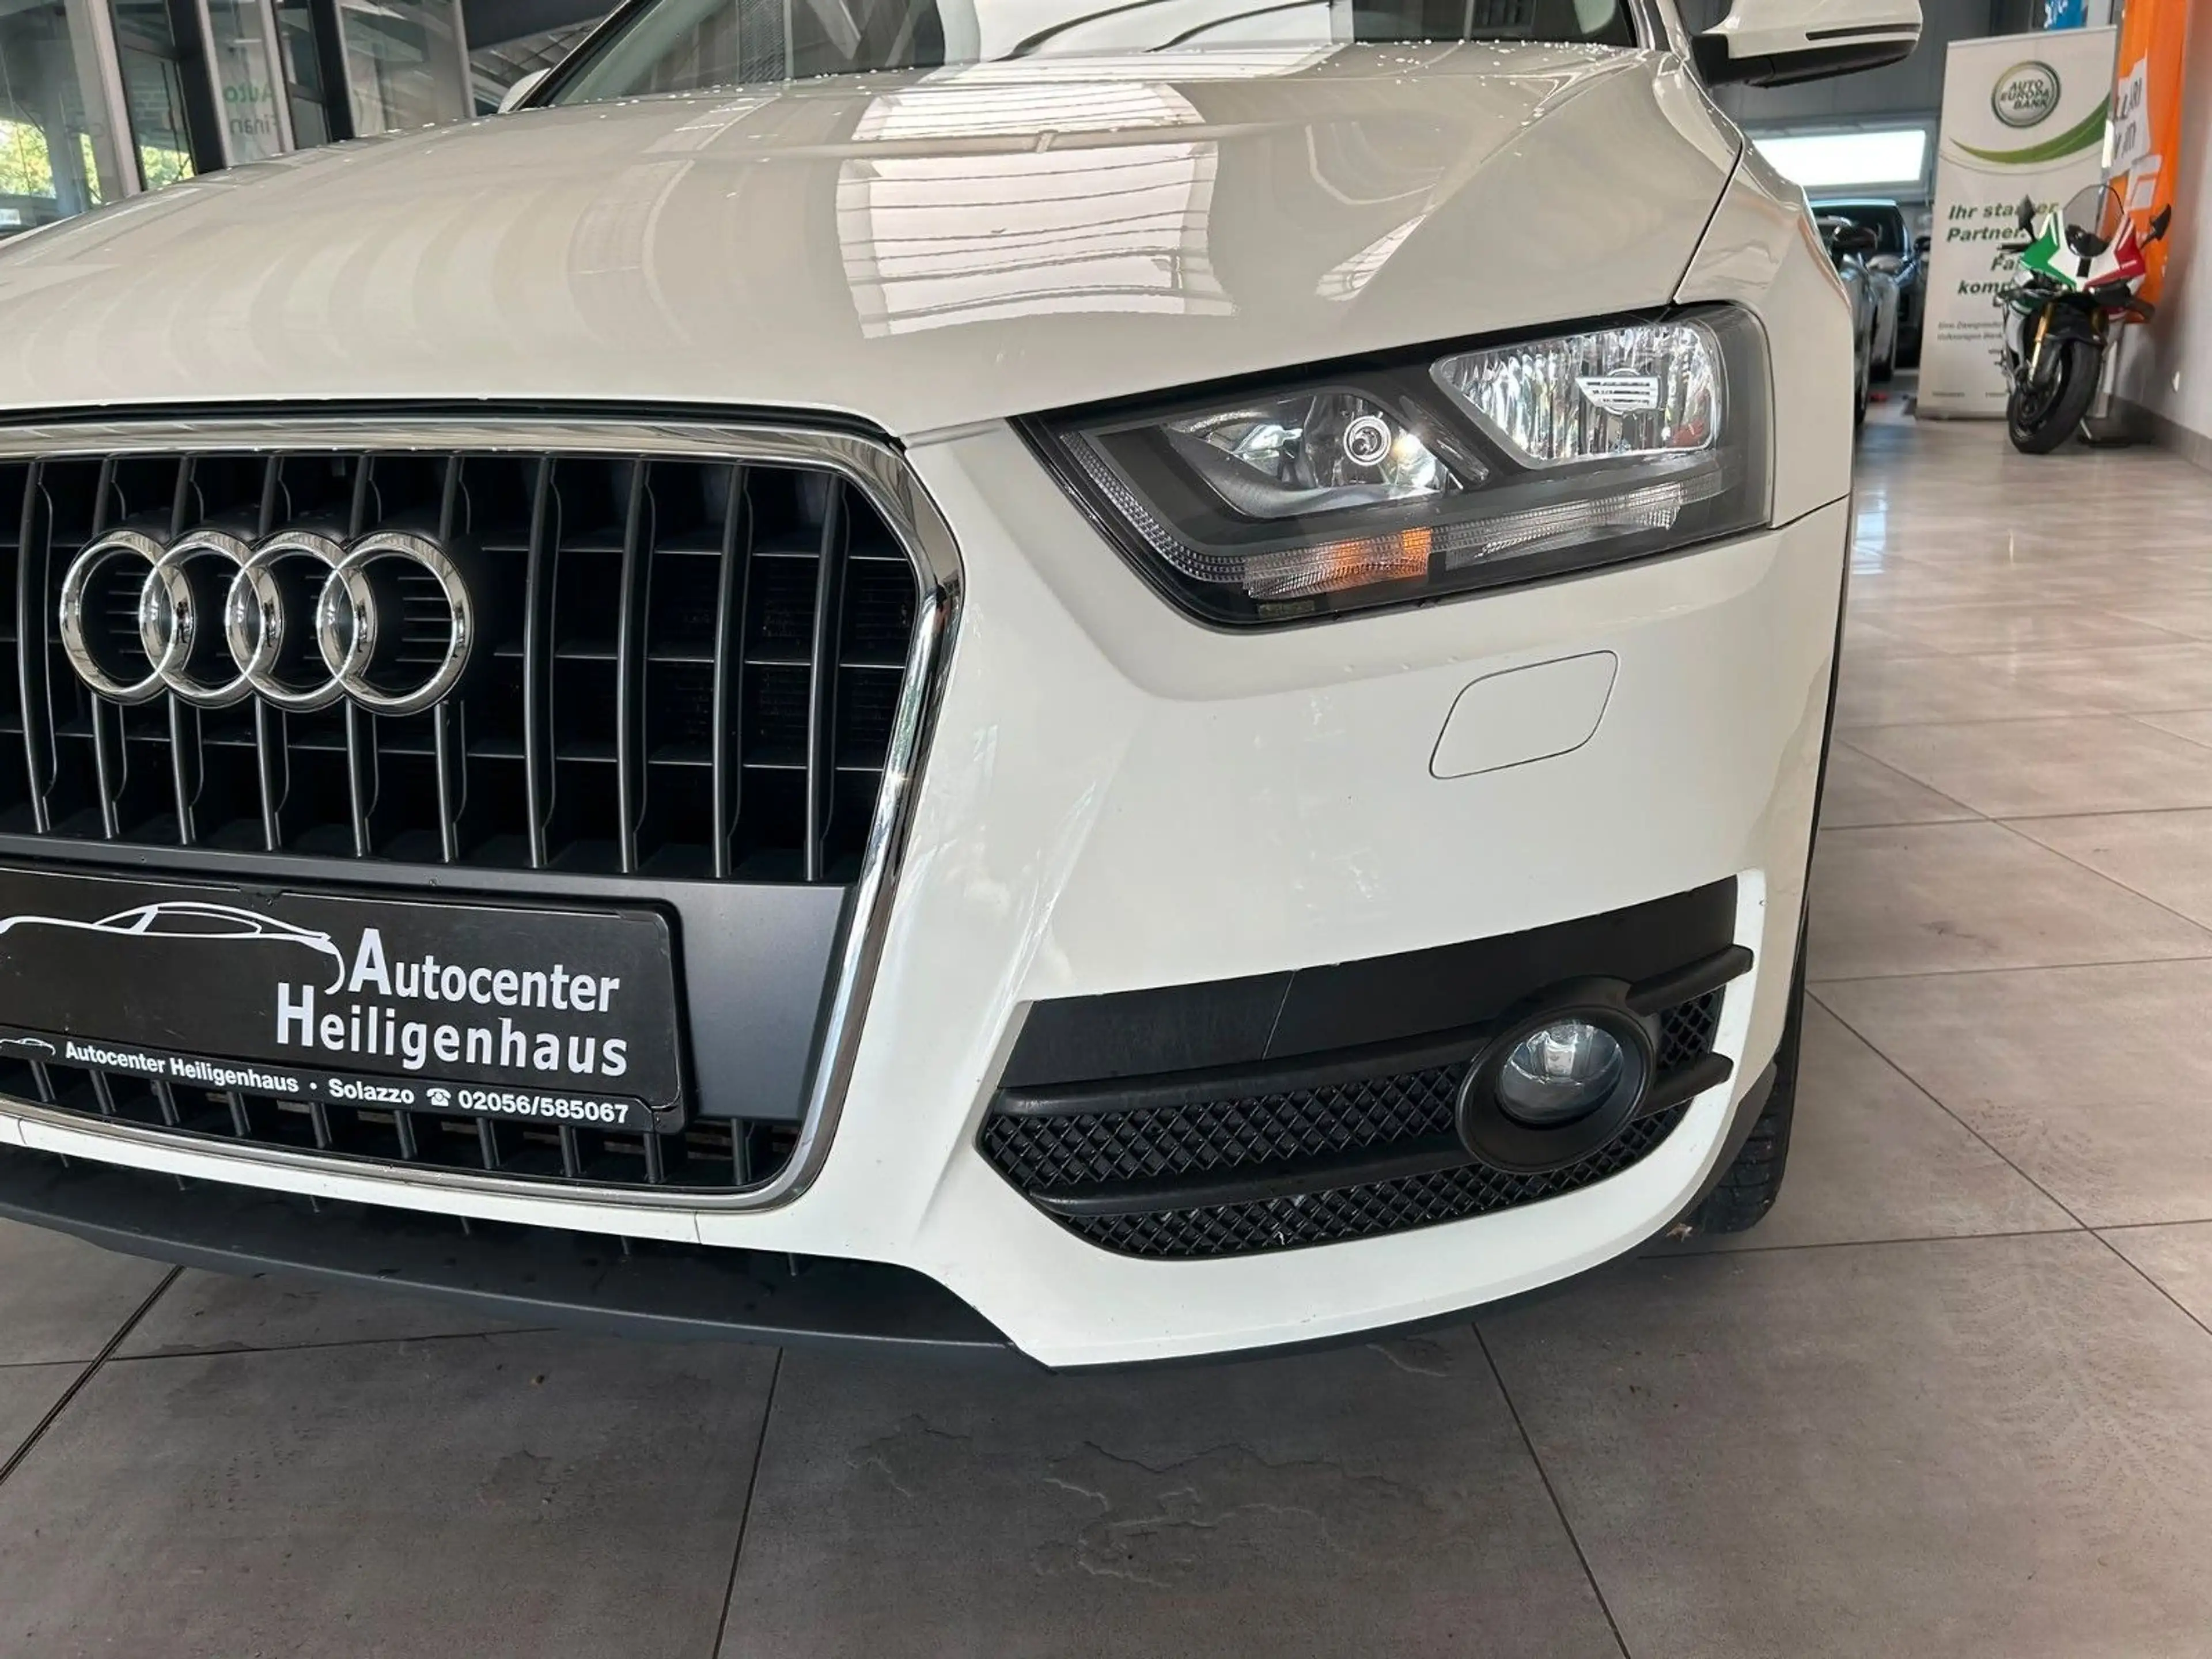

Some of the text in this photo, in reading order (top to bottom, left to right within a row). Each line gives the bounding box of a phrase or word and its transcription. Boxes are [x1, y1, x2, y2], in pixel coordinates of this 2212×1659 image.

[2010, 79, 2043, 92] AUTO
[2001, 89, 2049, 101] EUROPA
[2013, 100, 2047, 109] BANK
[1949, 202, 2059, 220] Ihr staer
[348, 928, 620, 1012] Autocenter
[276, 982, 627, 1076] Heiligenhaus
[65, 1041, 629, 1124] Autocenter Heiligenhaus Solazzo 02056/585067
